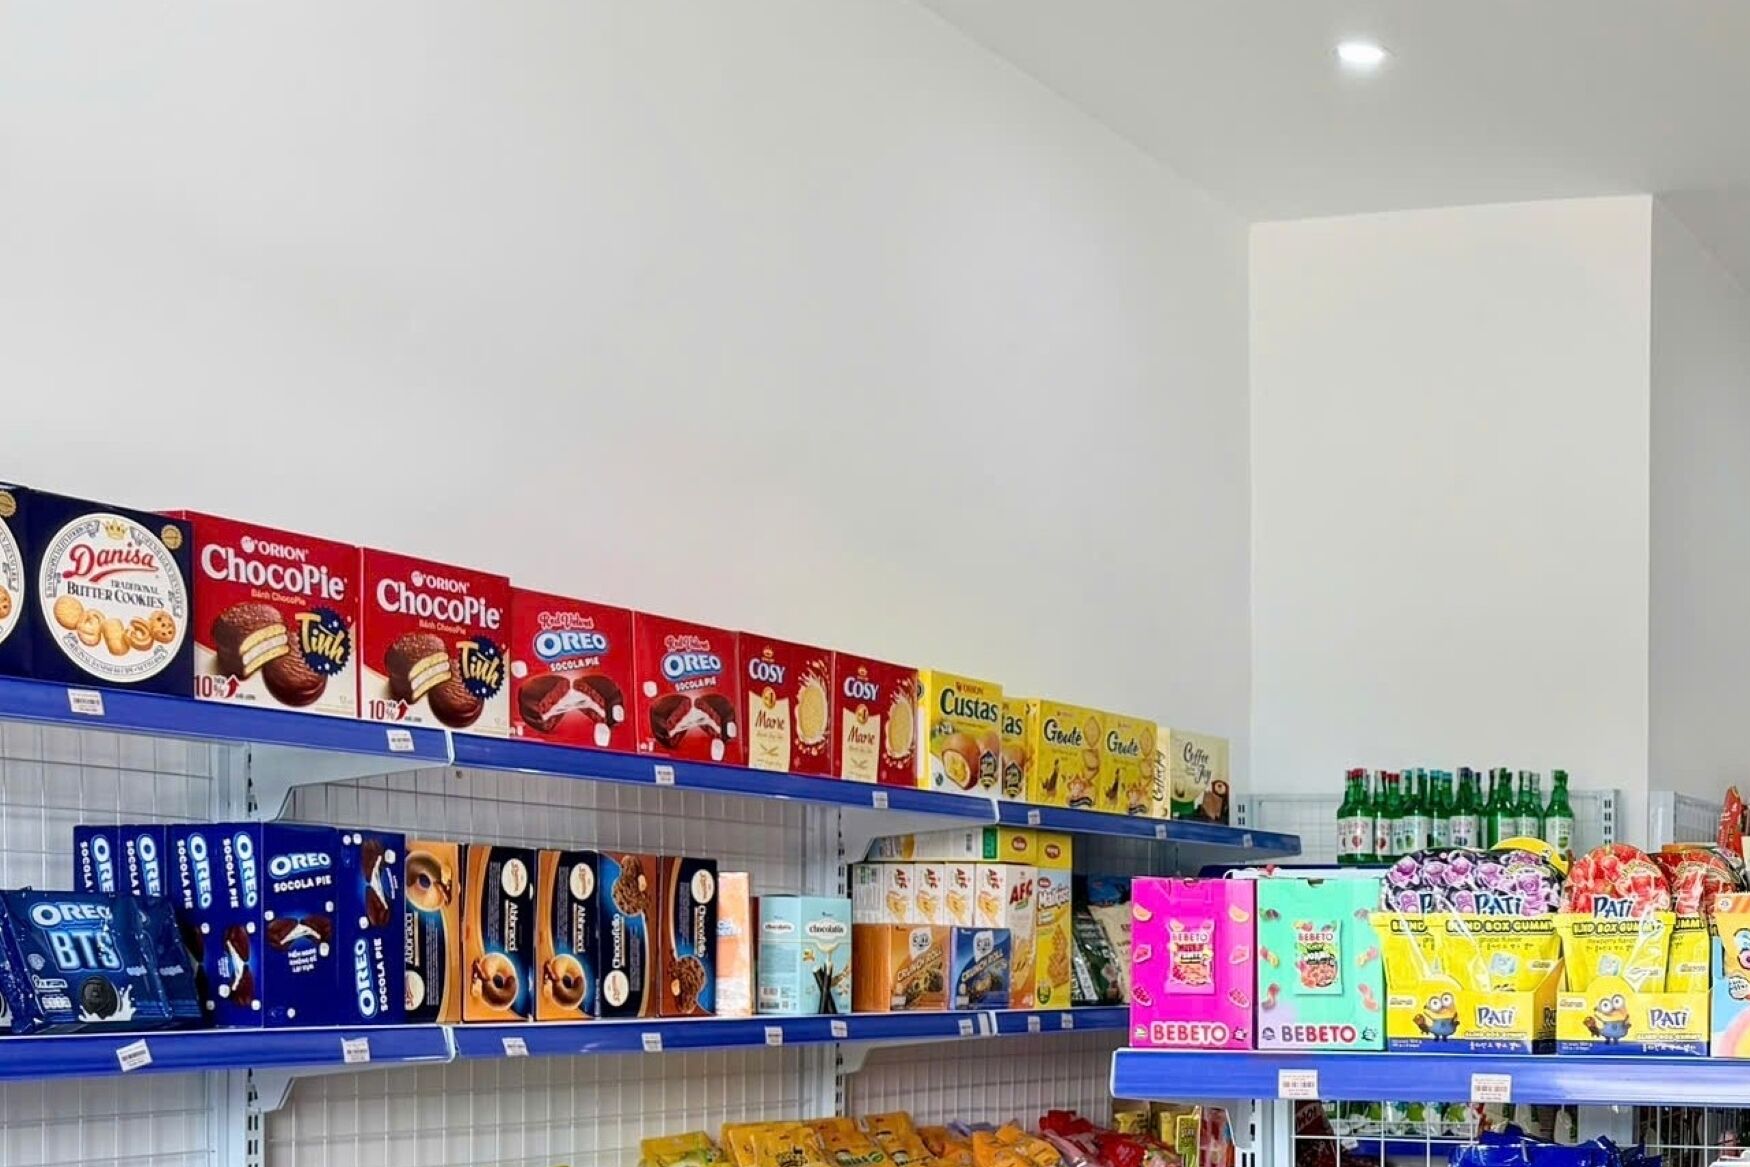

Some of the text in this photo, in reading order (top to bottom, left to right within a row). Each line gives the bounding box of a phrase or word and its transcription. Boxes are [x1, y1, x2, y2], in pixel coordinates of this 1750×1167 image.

[62, 542, 156, 580] Danisa
[256, 541, 307, 563] ORION
[201, 543, 345, 601] ChocoPie
[67, 580, 165, 609] BUTTER COOKIES
[425, 577, 468, 595] ORION
[376, 578, 501, 630] ChocoPie
[534, 632, 608, 657] OREO
[551, 656, 600, 672] SOCOLA PIE
[663, 653, 722, 678] OREO
[748, 658, 786, 685] COSY
[843, 676, 880, 701] COSY
[939, 688, 999, 722] Custas
[91, 834, 114, 893] ORE
[189, 834, 213, 909] OREO
[234, 833, 258, 909] OREO
[268, 852, 332, 877] OREO
[273, 875, 332, 893] SOCOLA PIE
[1009, 879, 1034, 906] AFC
[50, 930, 122, 973] BTS
[355, 937, 376, 1018] OREO
[373, 937, 390, 1013] SOCOLA PIE
[1153, 1023, 1227, 1045] BEBETO
[1281, 1023, 1356, 1045] BEBETO
